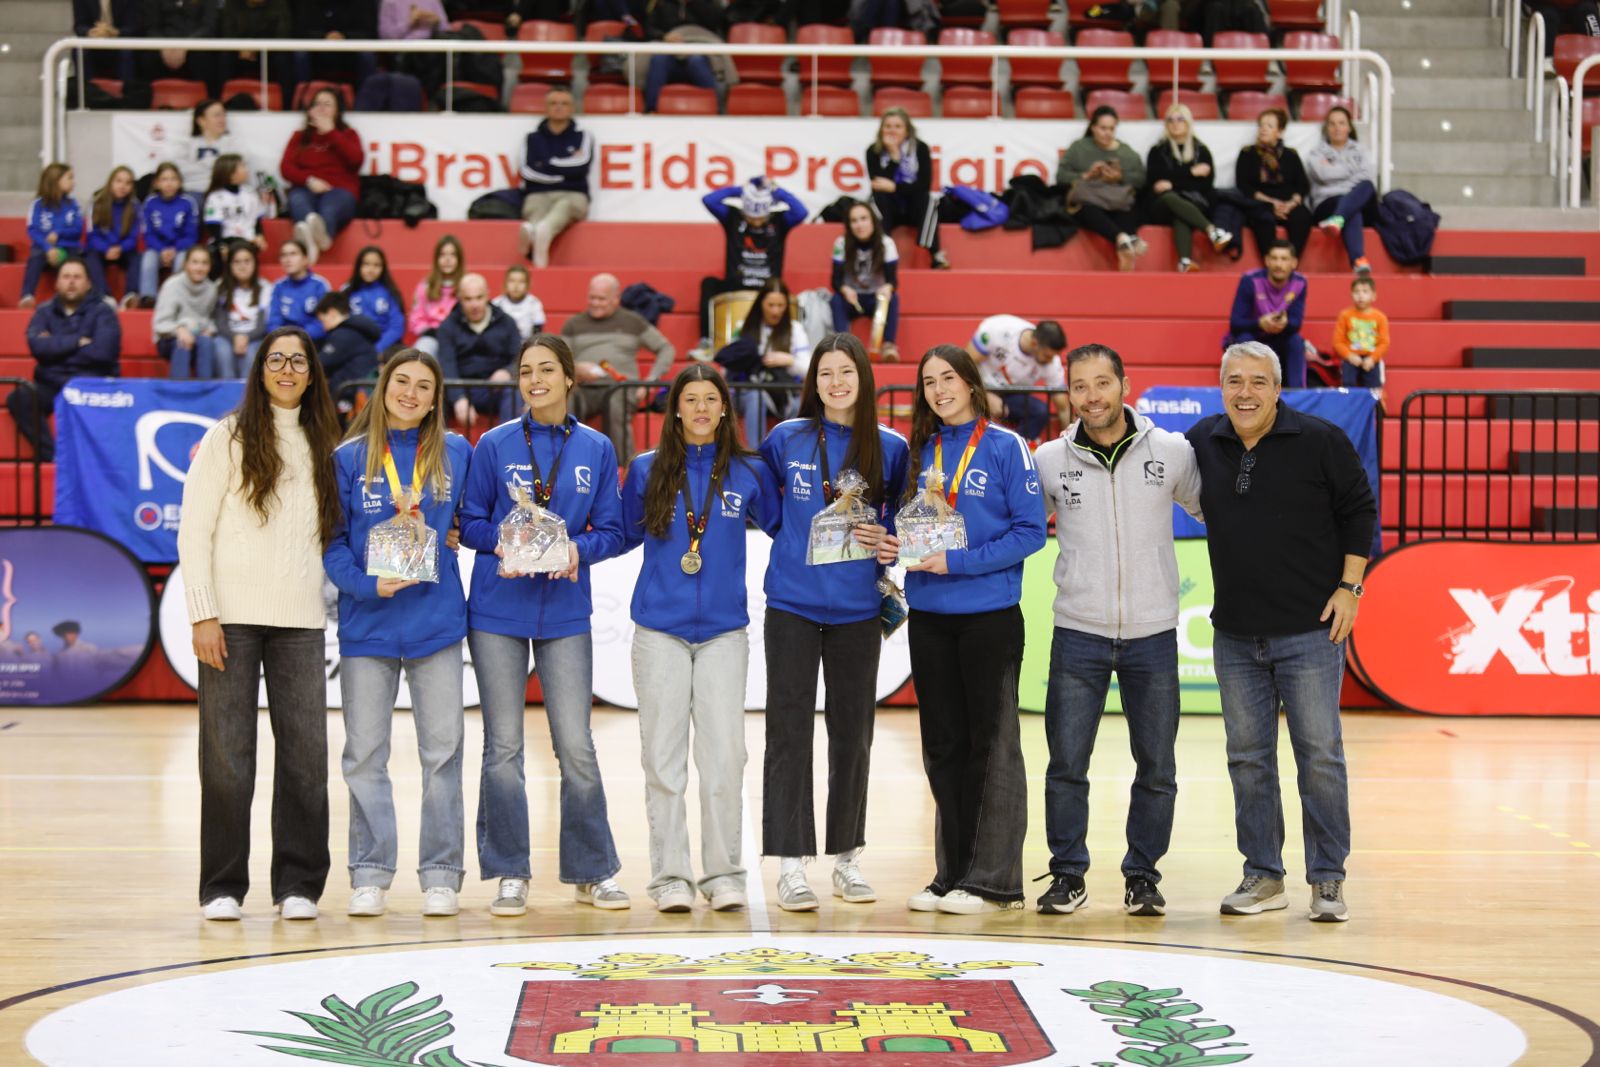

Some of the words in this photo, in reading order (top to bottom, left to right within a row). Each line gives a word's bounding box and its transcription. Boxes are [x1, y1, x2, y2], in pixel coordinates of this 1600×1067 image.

[599, 142, 736, 191] Elda
[793, 487, 811, 496] ELDA
[363, 500, 382, 508] ELDA
